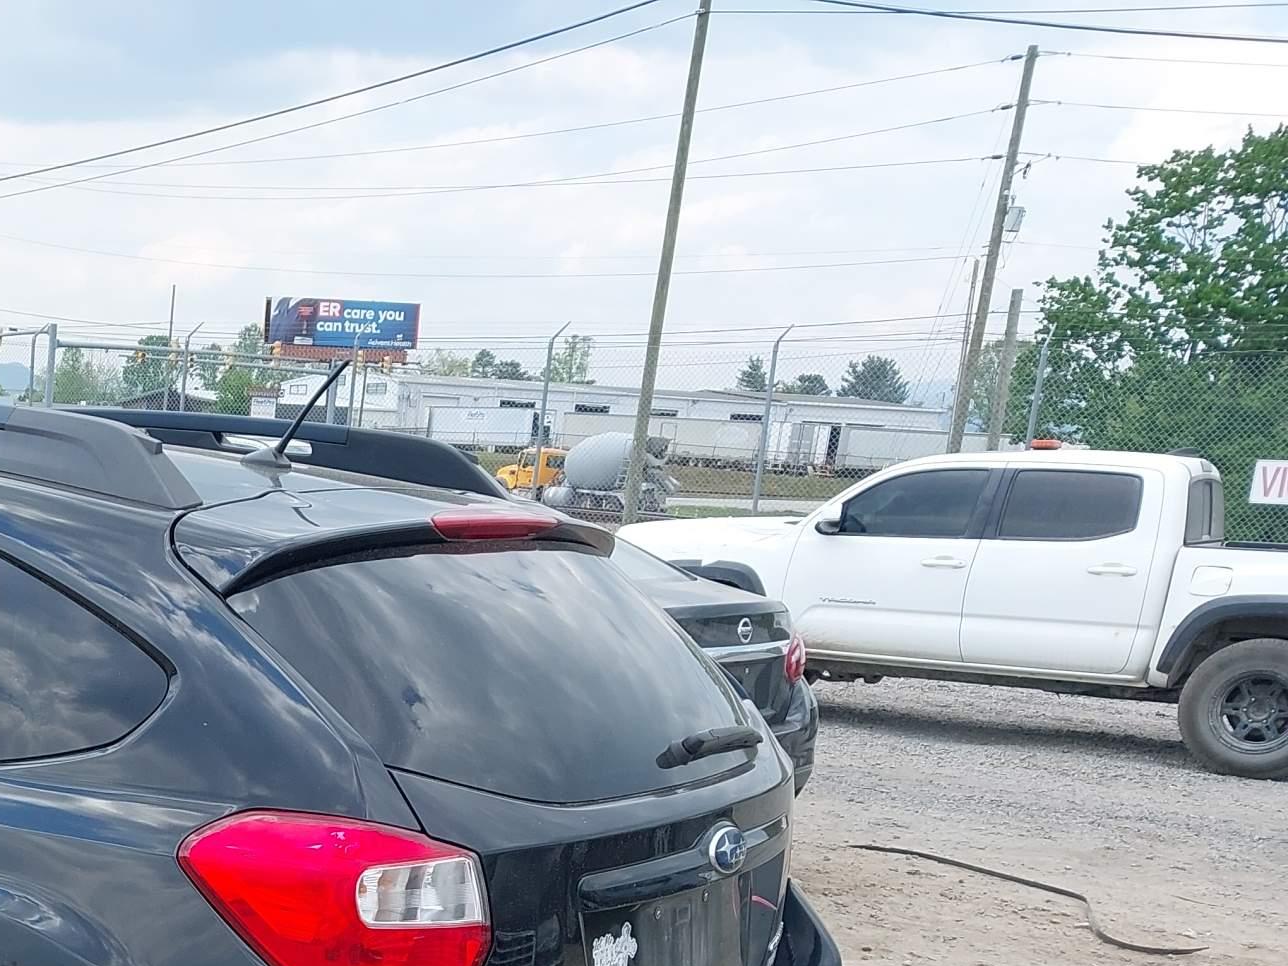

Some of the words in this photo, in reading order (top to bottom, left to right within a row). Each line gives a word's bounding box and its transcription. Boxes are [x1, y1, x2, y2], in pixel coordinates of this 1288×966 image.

[319, 302, 341, 317] ER
[343, 308, 375, 319] care
[378, 310, 405, 323] you
[316, 321, 342, 332] can
[344, 320, 381, 334] trust.
